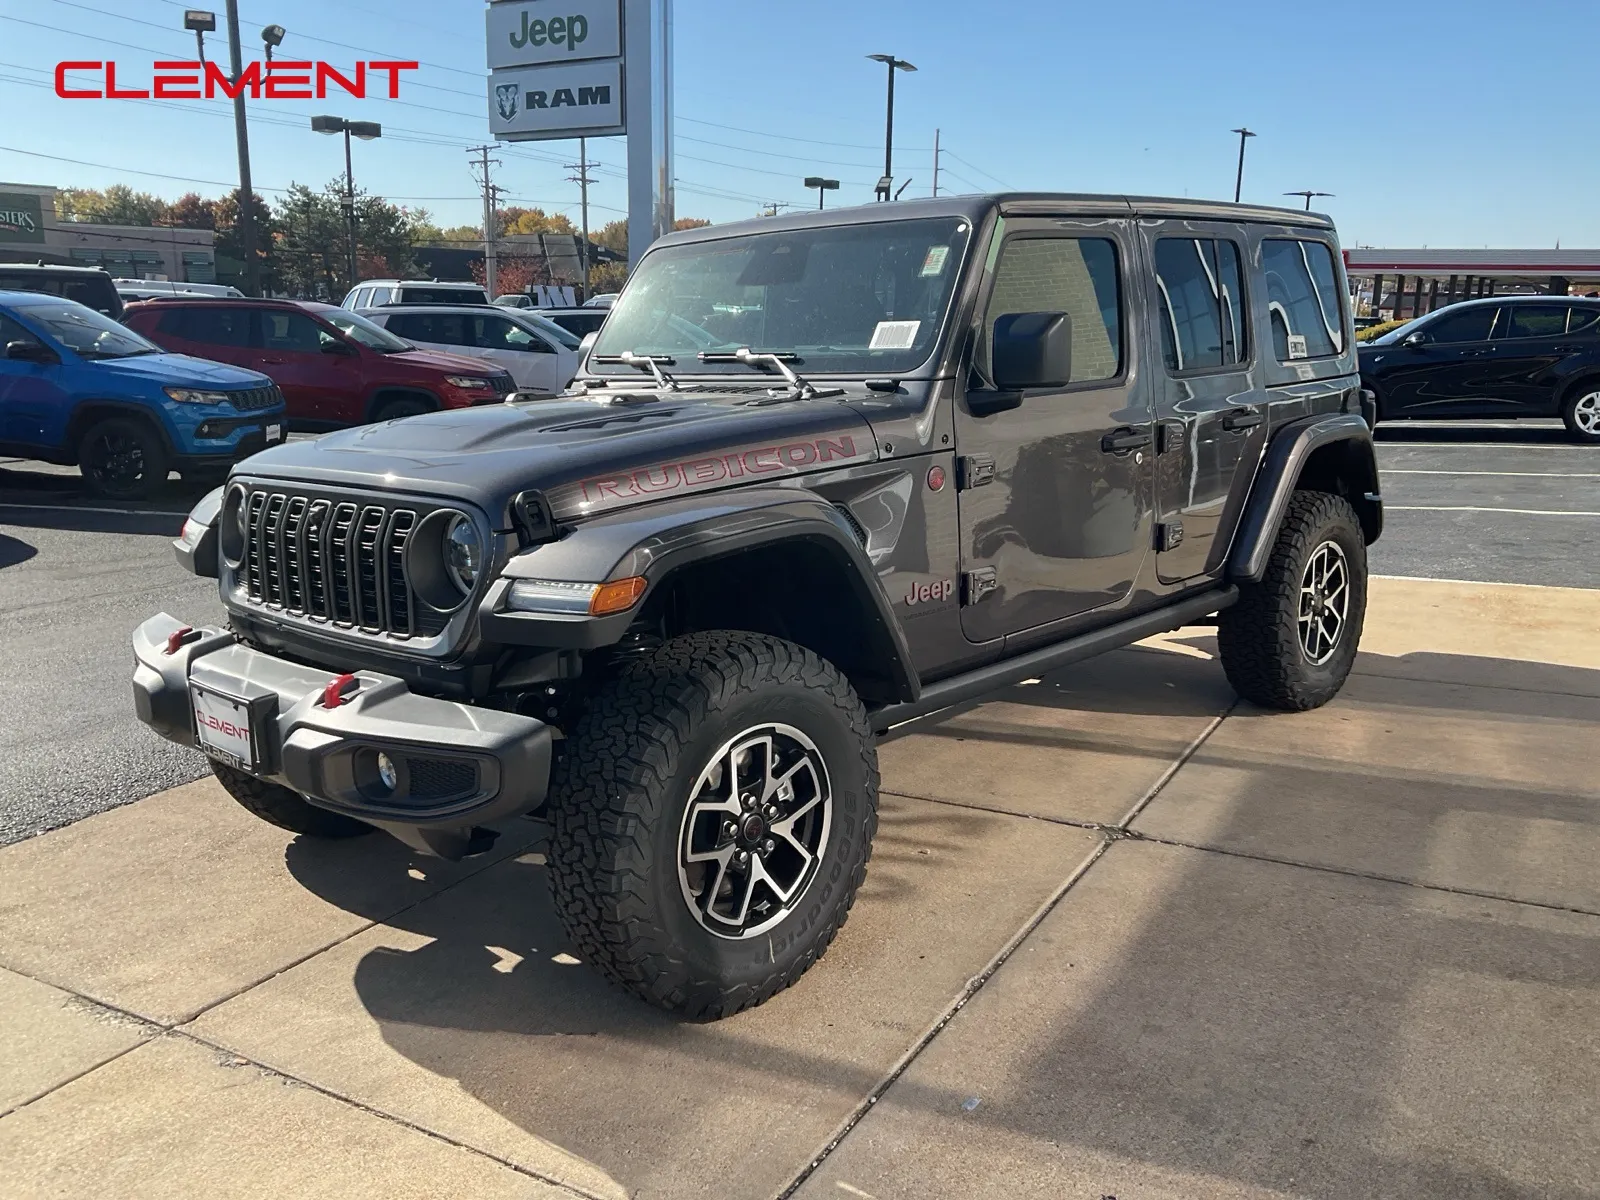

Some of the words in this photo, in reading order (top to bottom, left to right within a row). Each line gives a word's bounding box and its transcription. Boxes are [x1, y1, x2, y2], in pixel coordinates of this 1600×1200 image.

[509, 11, 588, 51] Jeep
[526, 85, 611, 110] RAM
[580, 436, 856, 502] RUBICON
[905, 579, 953, 606] Jeep
[197, 710, 250, 741] CLEMENT
